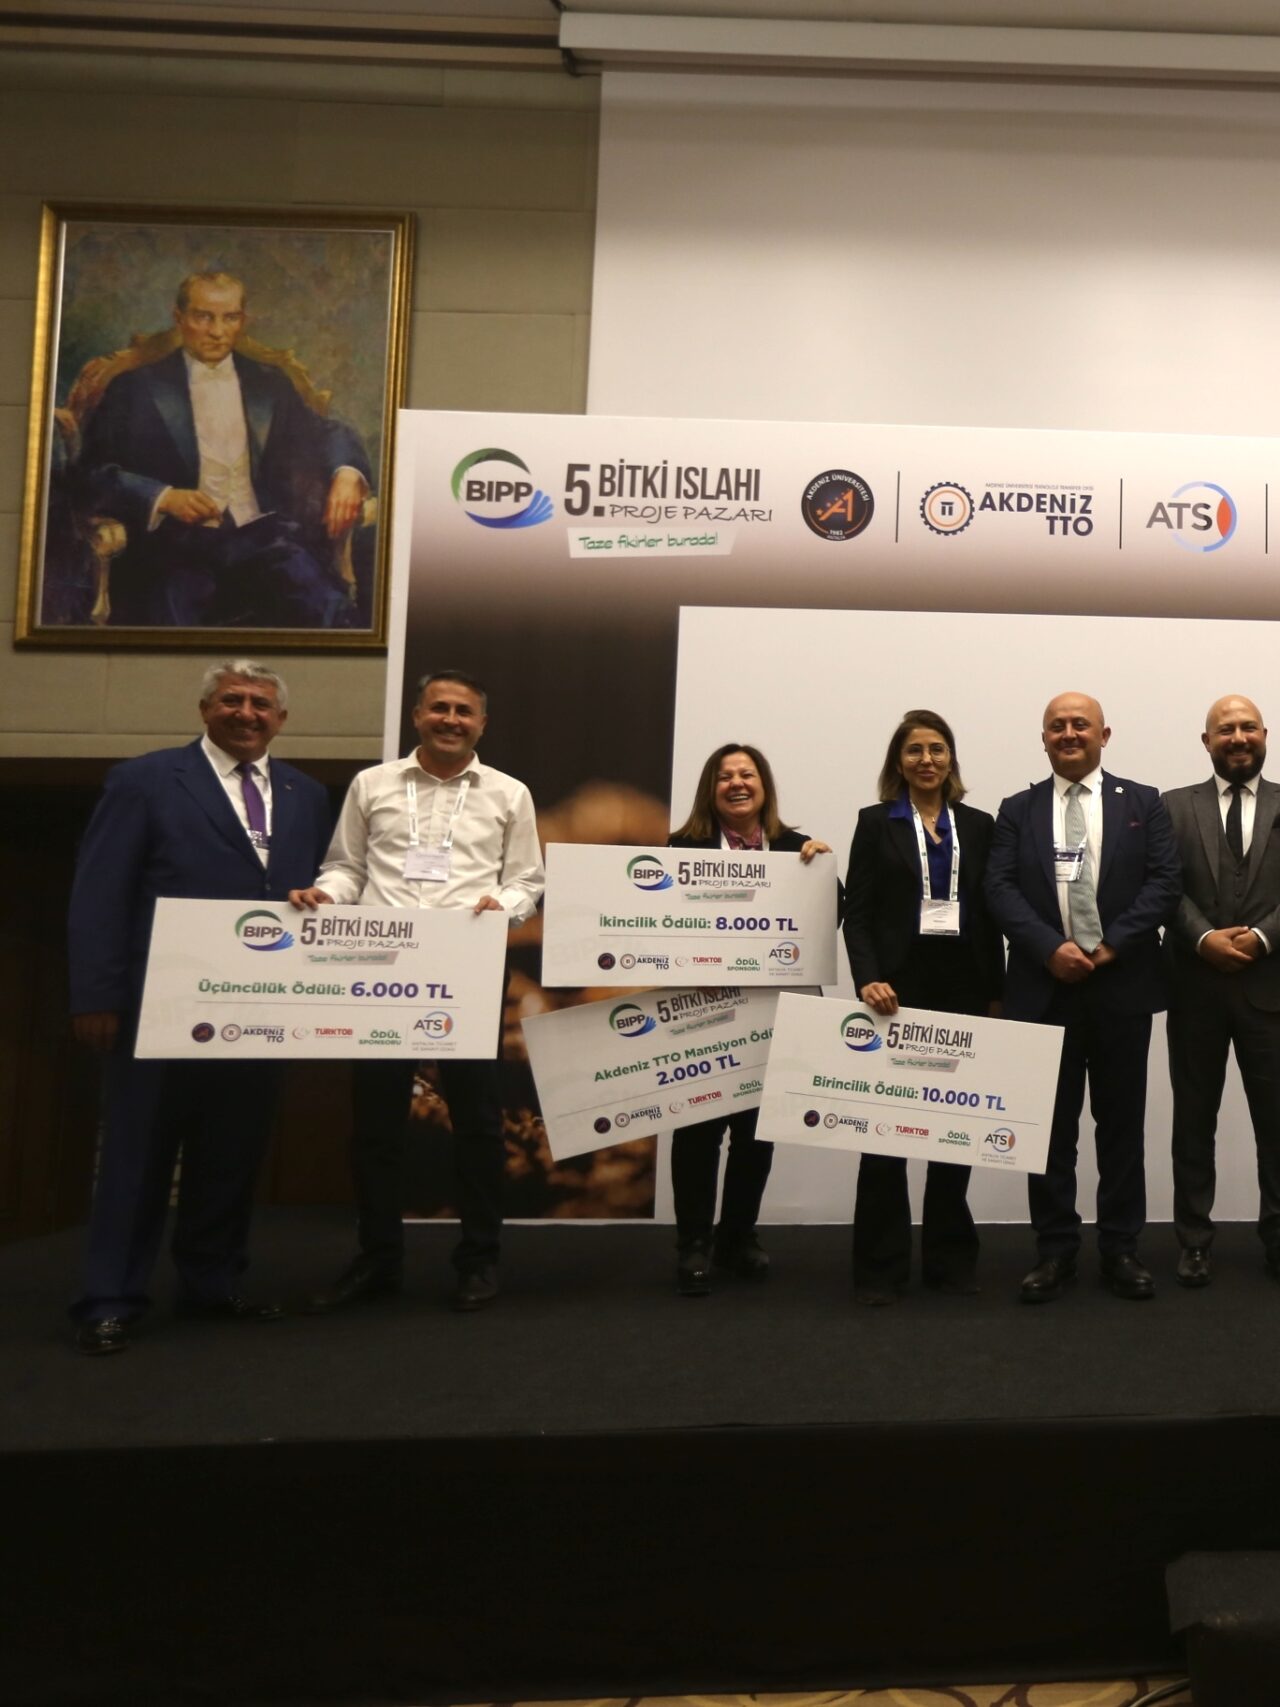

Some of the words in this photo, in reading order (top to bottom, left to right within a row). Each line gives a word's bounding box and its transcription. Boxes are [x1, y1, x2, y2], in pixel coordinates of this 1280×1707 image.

[466, 480, 533, 502] BIPP
[564, 463, 605, 517] 5.
[599, 458, 668, 498] BİTKİ
[675, 466, 760, 501] ISLAHI
[609, 504, 677, 523] PROJE
[684, 506, 772, 522] PAZARI
[1046, 515, 1093, 536] TTO
[578, 537, 613, 550] Taze
[618, 535, 663, 549] fikirler
[633, 868, 664, 879] BIPP
[678, 861, 697, 886] 5.
[693, 860, 725, 878] BİTKİ
[728, 863, 765, 879] ISLAHI
[243, 926, 283, 938] BIPP
[300, 918, 325, 946] 5.
[320, 916, 362, 937] BİTKİ
[364, 920, 413, 939] ISLAHI
[600, 913, 657, 929] İkincilik
[662, 915, 712, 929] Ödülü:
[715, 916, 771, 931] 8.000
[775, 918, 799, 932] TL
[198, 978, 287, 996] Üçüncülük
[292, 981, 346, 996] Ödülü:
[351, 981, 419, 999] 6.000
[425, 983, 453, 1000] TL
[616, 1014, 646, 1029] BIPP
[656, 1000, 678, 1023] 5.
[267, 1035, 284, 1043] TTO
[370, 1029, 401, 1038] ÖDÜL
[846, 1026, 875, 1040] BIPP
[886, 1022, 904, 1050] 5.
[902, 1022, 934, 1043] BİTKİ
[934, 1027, 973, 1049] ISLAHI
[594, 1060, 650, 1082] Akdeniz
[653, 1052, 681, 1067] TTO
[685, 1037, 747, 1060] Mansiyon
[656, 1060, 712, 1086] 2.000
[715, 1053, 741, 1071] TL
[813, 1075, 871, 1093] Birincilik
[874, 1081, 919, 1100] Ödülü:
[922, 1086, 980, 1108] 10.000
[986, 1094, 1006, 1111] TL
